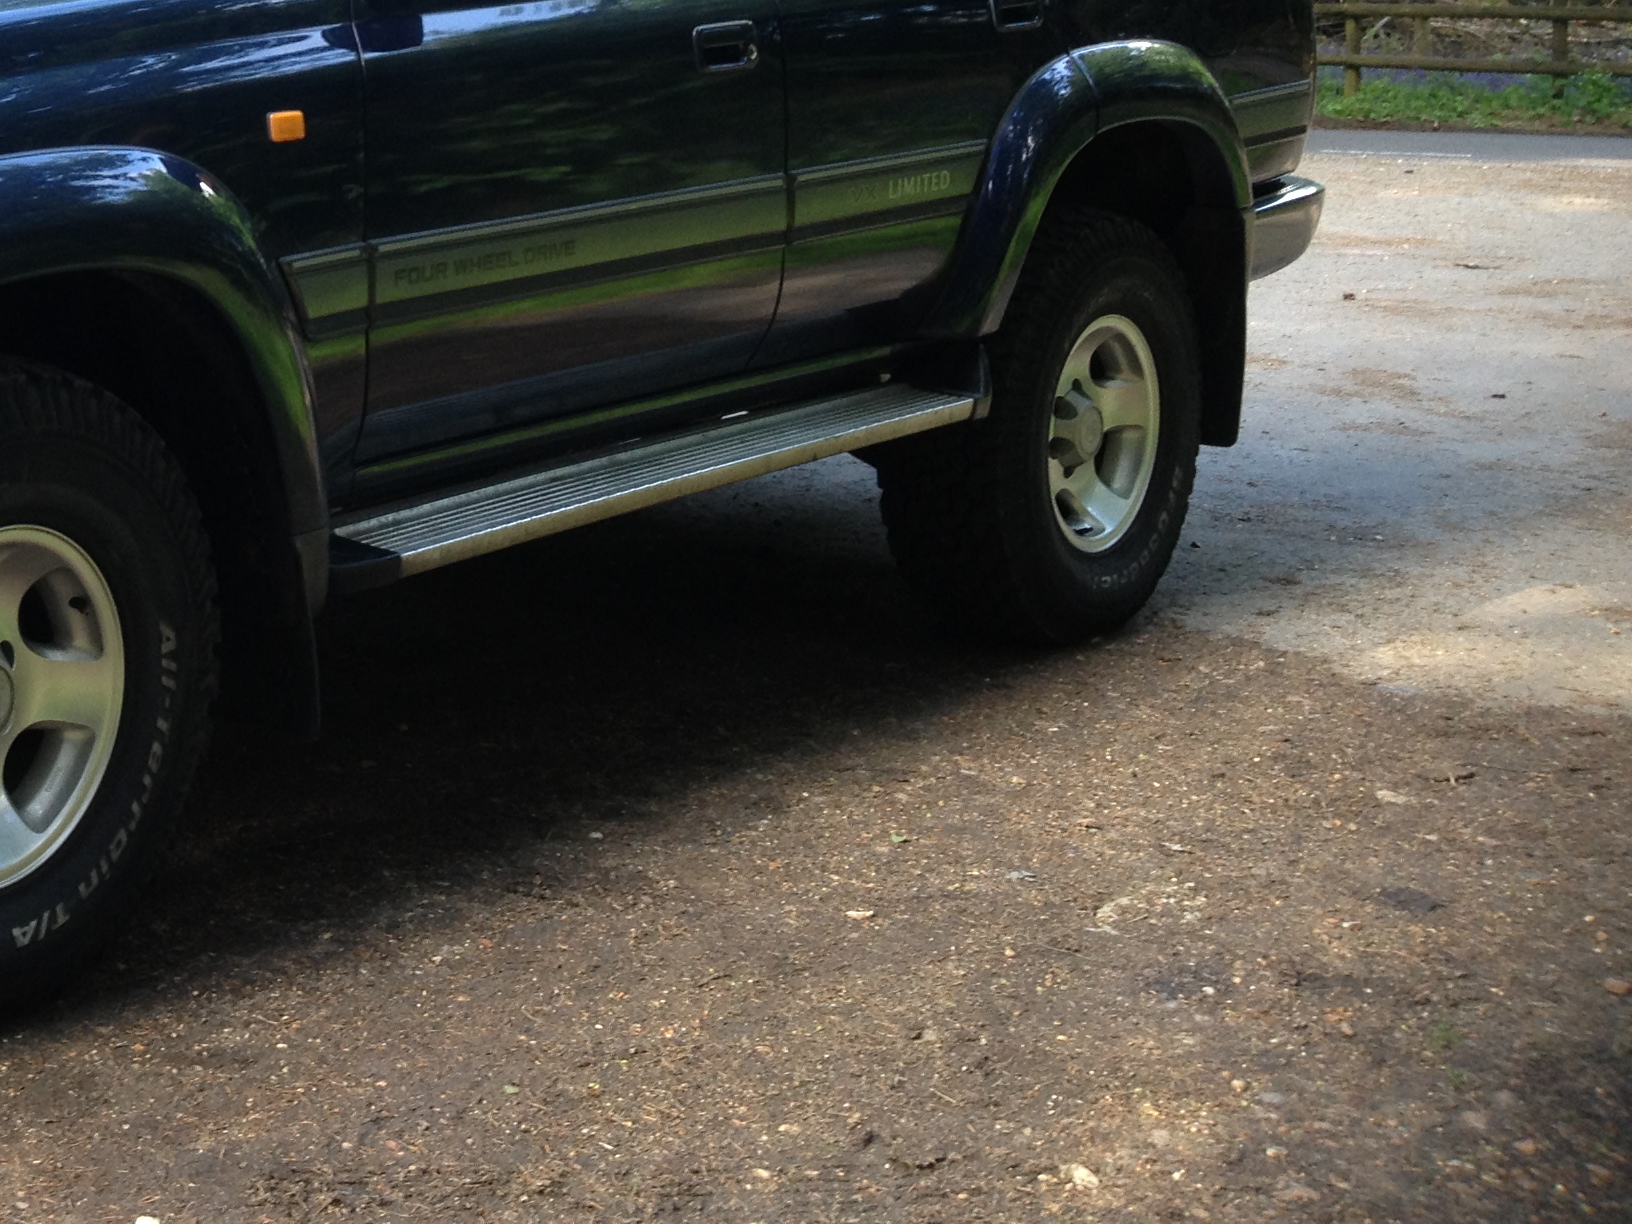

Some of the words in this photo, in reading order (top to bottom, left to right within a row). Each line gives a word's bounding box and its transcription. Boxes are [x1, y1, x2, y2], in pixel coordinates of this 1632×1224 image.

[888, 170, 951, 199] LIMITED
[393, 261, 449, 286] FOUR
[453, 249, 520, 276] WHEEL
[522, 238, 577, 265] DRIVE
[10, 902, 72, 949] T/A
